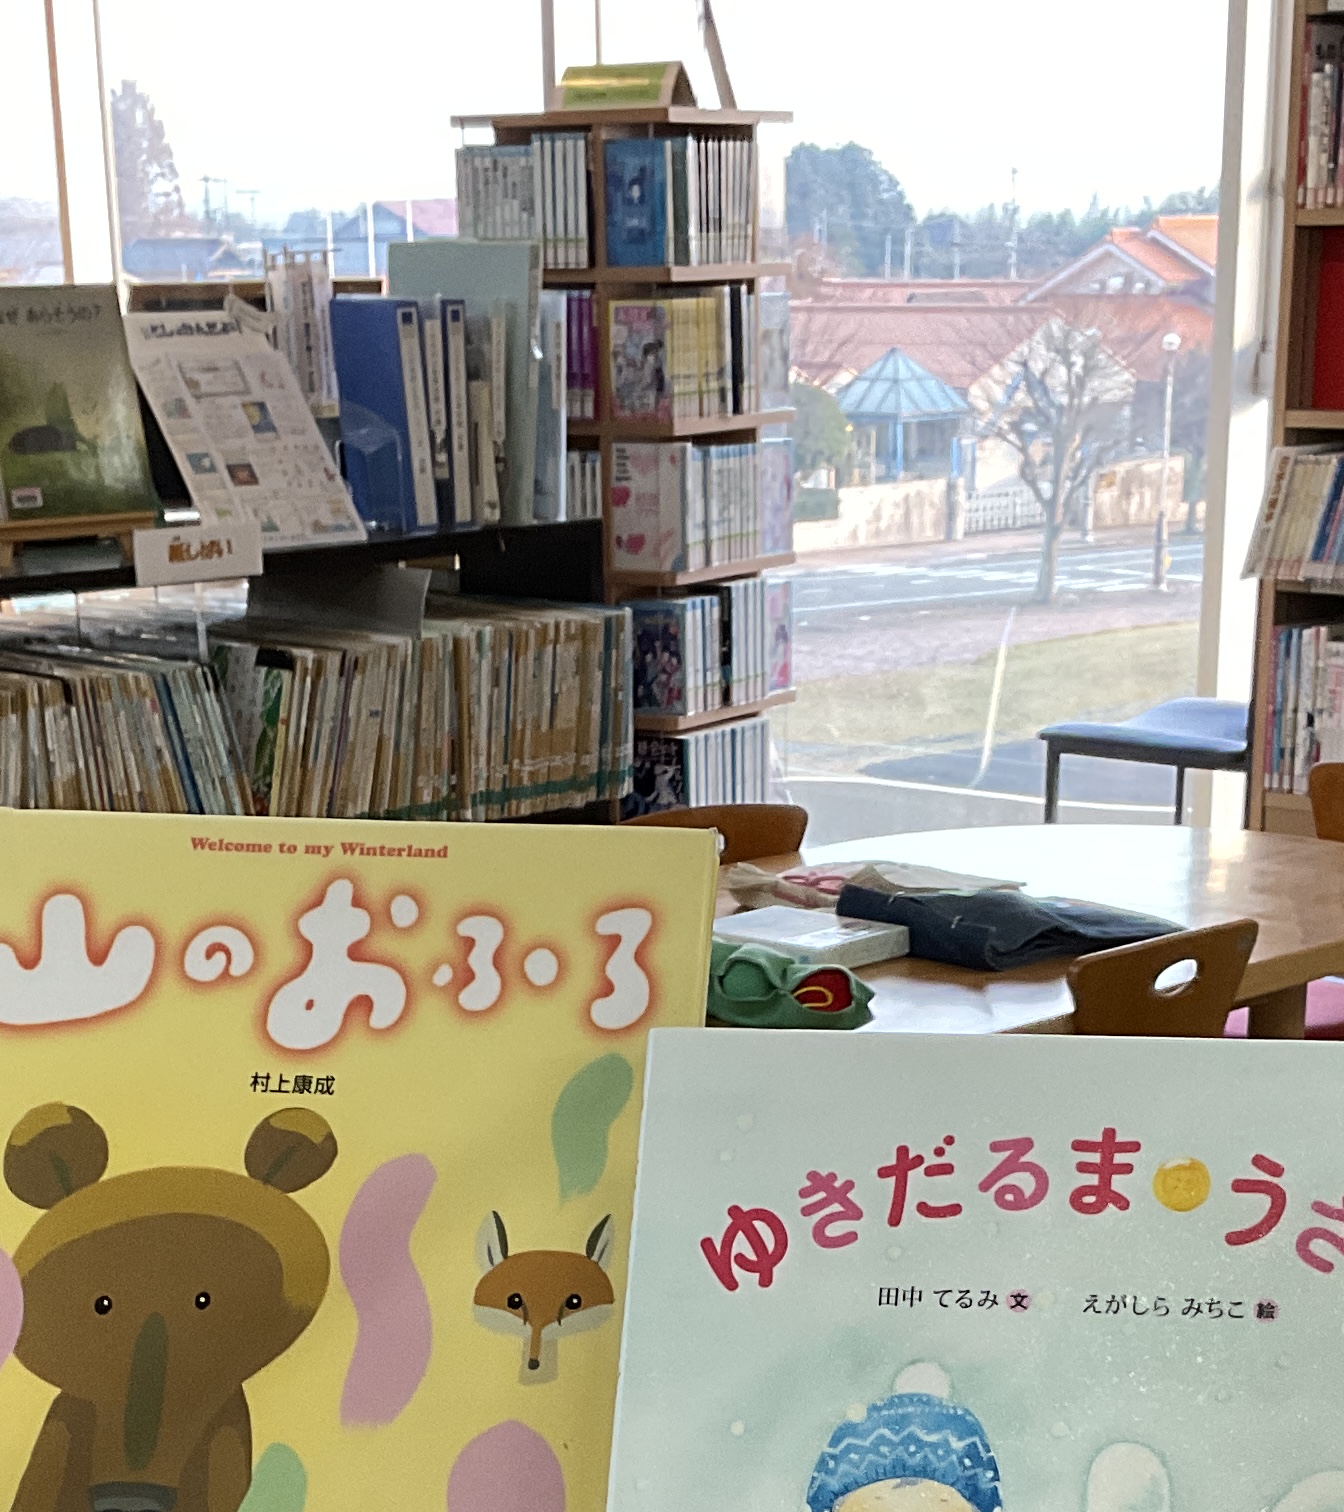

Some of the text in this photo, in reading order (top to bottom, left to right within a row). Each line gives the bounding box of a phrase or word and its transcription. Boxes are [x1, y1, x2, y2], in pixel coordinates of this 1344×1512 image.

[190, 836, 449, 861] Welcome to my Winterland
[249, 1073, 336, 1098] 村上康成
[877, 1286, 1030, 1312] 田中 てるみ 文
[1082, 1295, 1171, 1318] えがしら
[1181, 1297, 1246, 1320] みちこ
